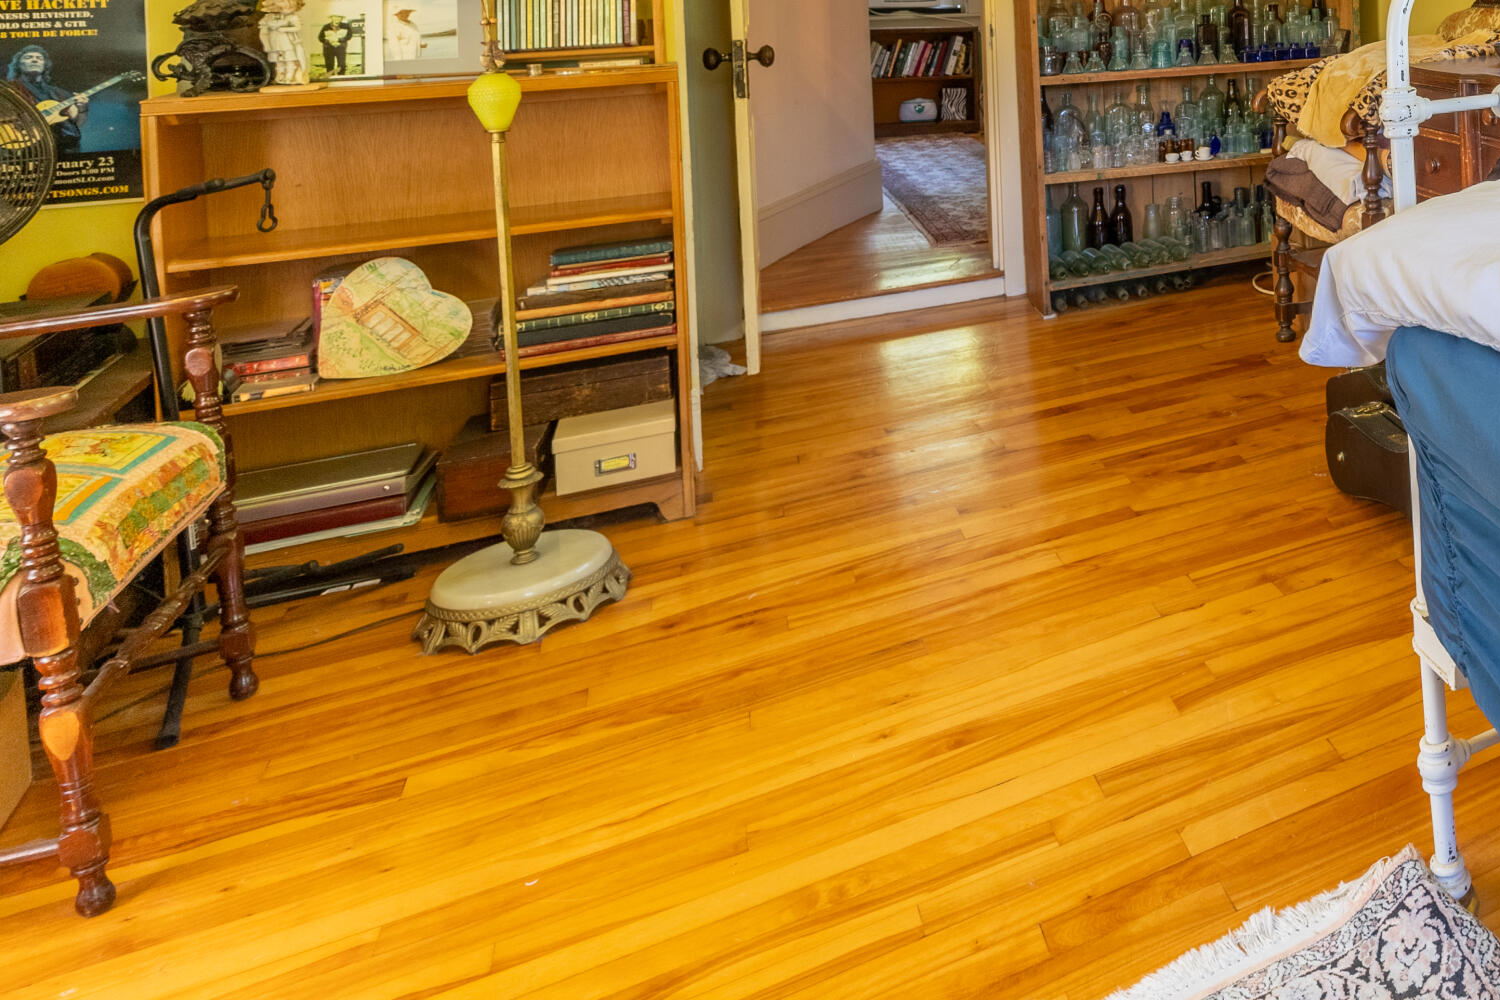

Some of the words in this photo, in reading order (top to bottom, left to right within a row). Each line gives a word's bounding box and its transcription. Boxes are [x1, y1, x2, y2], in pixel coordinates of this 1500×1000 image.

[21, 21, 52, 29] GEMS
[54, 21, 62, 29] &
[64, 20, 87, 28] GTR
[9, 30, 41, 39] TOUR
[42, 30, 57, 38] DE
[97, 156, 115, 167] 23
